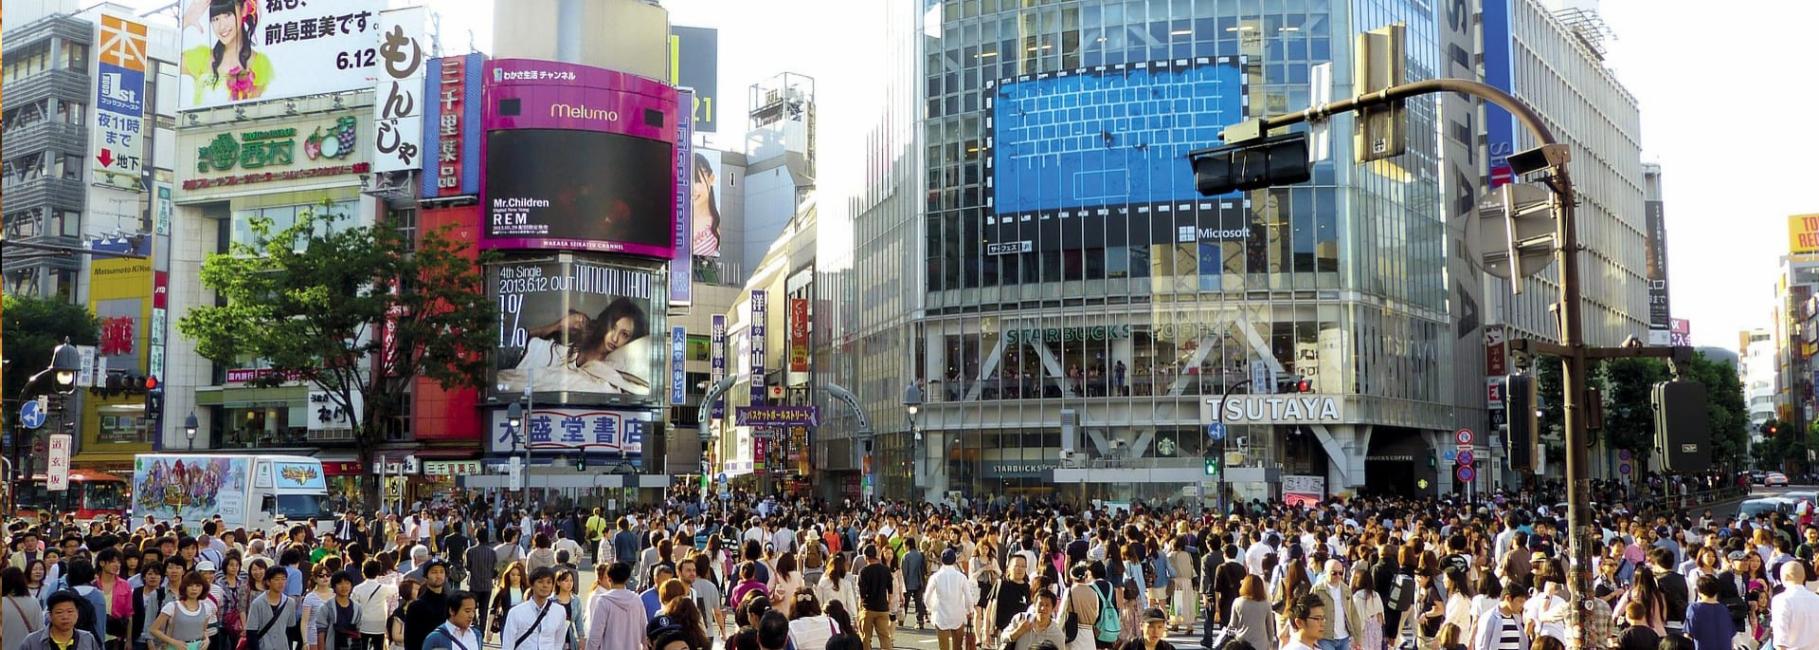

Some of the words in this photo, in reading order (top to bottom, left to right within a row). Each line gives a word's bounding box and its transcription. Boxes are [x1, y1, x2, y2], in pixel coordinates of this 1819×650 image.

[265, 11, 378, 45] 前島亜美です。
[100, 20, 147, 67] 本
[337, 48, 376, 70] 6.12
[504, 71, 537, 80] わかさ生活
[539, 70, 576, 80] チャンネル
[377, 25, 421, 166] もんじゃ
[98, 112, 140, 133] 夜11時
[438, 61, 459, 188] 三千里薬品
[106, 131, 131, 147] まで
[116, 154, 139, 170] 地下
[493, 198, 549, 208] Mr.Children
[493, 213, 527, 225] REM
[1198, 227, 1250, 240] Microsoft
[500, 266, 514, 278] 4th
[516, 265, 542, 279] Single
[500, 277, 547, 293] 2013.6.12
[551, 276, 576, 291] OUT
[1007, 325, 1131, 345] STARBUCKS
[1206, 398, 1339, 421] TSUTAYA
[51, 440, 62, 484] 道玄坂
